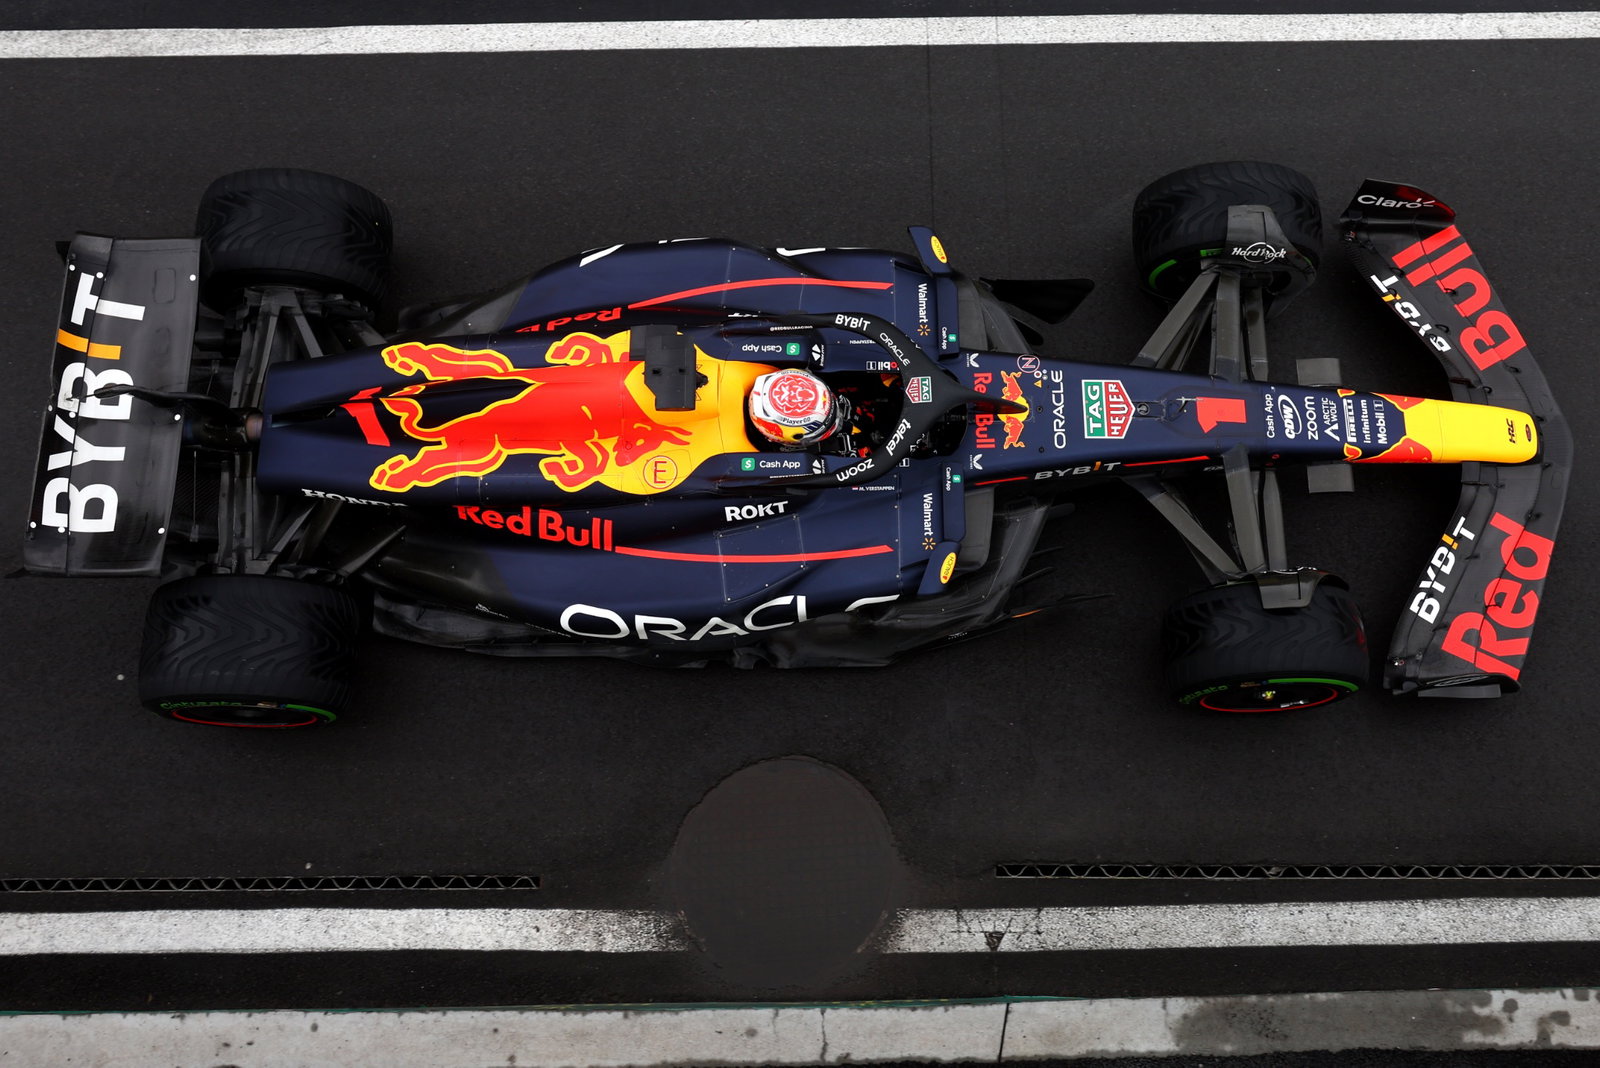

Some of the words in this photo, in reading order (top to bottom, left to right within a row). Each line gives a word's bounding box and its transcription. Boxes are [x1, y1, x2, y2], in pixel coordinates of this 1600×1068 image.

[1356, 194, 1424, 210] Claro
[1231, 247, 1259, 257] Hard
[1261, 247, 1287, 259] Rock
[918, 283, 928, 323] Walmart
[1391, 224, 1527, 371] Bull
[835, 313, 871, 332] BYBIT
[742, 344, 760, 353] App
[761, 344, 783, 353] Cash
[879, 332, 911, 366] ORACLE
[877, 360, 901, 371] obil
[907, 378, 920, 403] HEUER
[920, 377, 931, 401] TAG
[973, 372, 993, 394] Re
[42, 272, 145, 533] BYBIT
[1050, 370, 1067, 449] ORACLE
[1088, 384, 1103, 435] TAG
[1106, 383, 1125, 436] HEUER
[1265, 393, 1275, 412] App
[1320, 397, 1330, 425] ARCTIC
[1329, 400, 1340, 425] WOLF
[1374, 400, 1385, 411] 1
[974, 413, 996, 449] Bull
[1266, 414, 1275, 438] Cash
[1281, 404, 1296, 439] CDW
[1304, 395, 1319, 441] zoom
[1343, 398, 1358, 443] PIRELLI
[1374, 413, 1388, 444] Mobil
[1505, 418, 1517, 444] HRC
[885, 418, 912, 457] telcel
[759, 460, 781, 469] Cash
[783, 460, 801, 471] App
[836, 458, 875, 482] zoom
[1033, 461, 1122, 480] BYBIT
[724, 501, 789, 522] ROKT
[923, 493, 934, 536] Walmart
[452, 504, 532, 537] Red
[538, 509, 613, 552] Bull
[1409, 516, 1476, 624] BYBIT
[1441, 511, 1555, 682] Red
